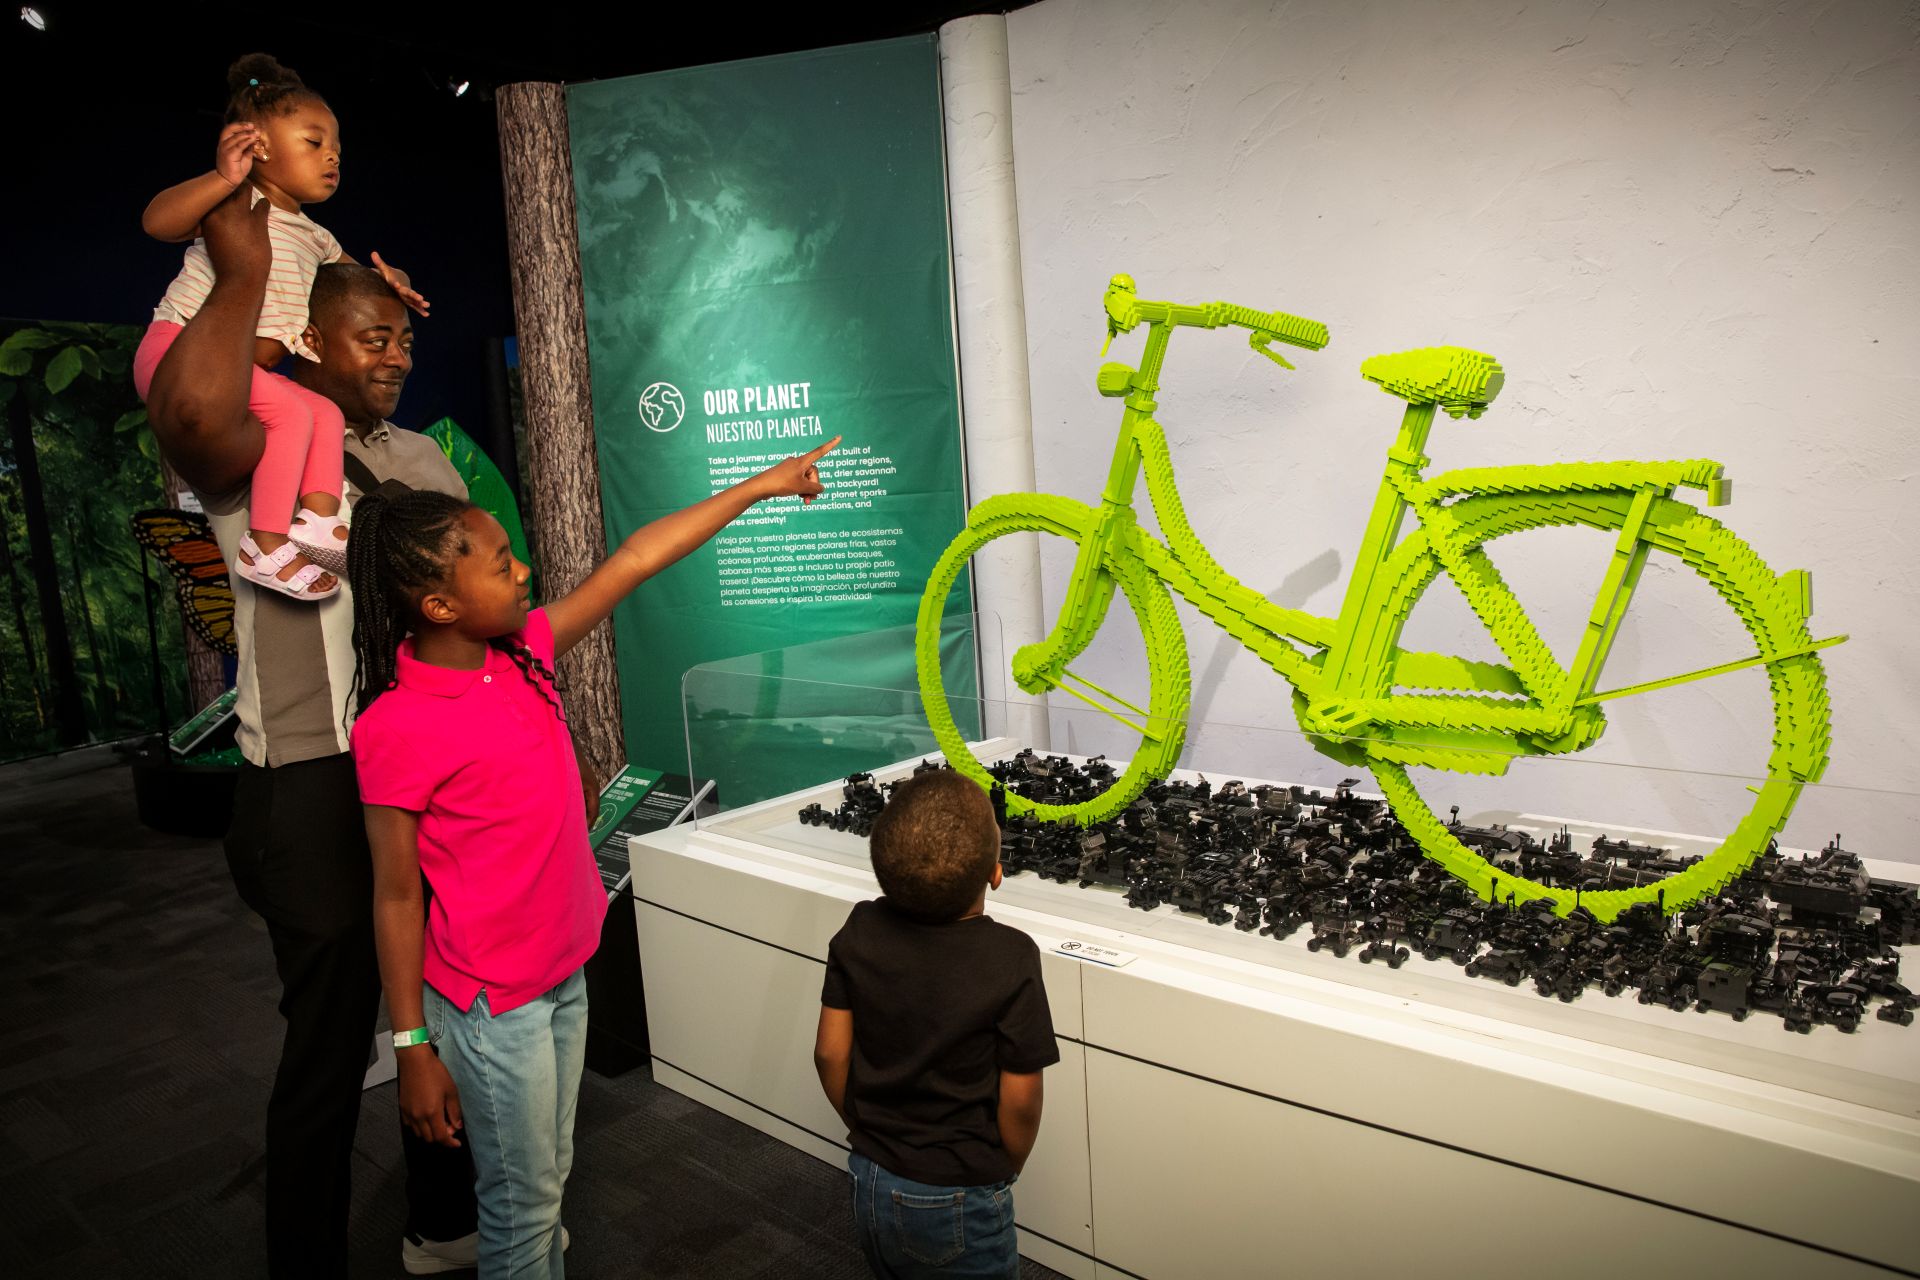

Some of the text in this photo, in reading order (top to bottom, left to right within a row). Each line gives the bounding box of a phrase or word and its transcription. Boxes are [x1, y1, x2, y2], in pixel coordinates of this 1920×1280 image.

[703, 382, 811, 416] OUR PLANET
[706, 415, 822, 444] NUESTRO PLANETA
[707, 457, 727, 465] Take
[735, 455, 766, 465] journey
[767, 451, 797, 461] around
[842, 447, 861, 455] built
[862, 446, 871, 454] of
[709, 465, 750, 475] incredible
[816, 459, 834, 468] cold
[835, 458, 857, 469] polar
[859, 456, 892, 467] regions,
[711, 477, 728, 486] vast
[834, 469, 853, 478] drier
[855, 466, 897, 476] savannah
[837, 478, 879, 489] backyard!
[816, 492, 829, 500] our
[831, 490, 857, 501] planet
[859, 488, 887, 499] sparks
[765, 504, 800, 515] deepens
[801, 501, 854, 511] connections,
[855, 500, 872, 508] and
[746, 515, 787, 525] creativity!
[739, 536, 752, 546] por
[754, 534, 784, 543] nuestro
[785, 532, 817, 543] planeta
[817, 531, 838, 539] lleno
[839, 530, 850, 538] de
[851, 528, 903, 537] ecosistemas
[756, 545, 780, 553] como
[781, 543, 816, 554] regiones
[817, 541, 848, 551] polares
[717, 550, 884, 566] océanos profundos, exuberantes bosques,
[718, 567, 753, 576] sabanas
[754, 565, 772, 574] más
[773, 564, 797, 573] secas
[805, 562, 834, 571] incluso
[835, 562, 844, 570] tu
[845, 561, 872, 571] propio
[873, 559, 895, 569] patio
[719, 577, 749, 586] trasero!
[791, 574, 816, 583] cómo
[817, 573, 825, 581] la
[826, 572, 855, 581] belleza
[856, 571, 867, 579] de
[869, 570, 900, 578] nuestro
[720, 588, 751, 598] planeta
[752, 586, 790, 596] despierta
[790, 585, 799, 593] la
[853, 581, 897, 592] profundiza
[721, 598, 733, 606] las
[734, 597, 779, 606] conexiones
[786, 595, 814, 605] inspira
[814, 594, 823, 602] la
[824, 592, 872, 602] creatividad!
